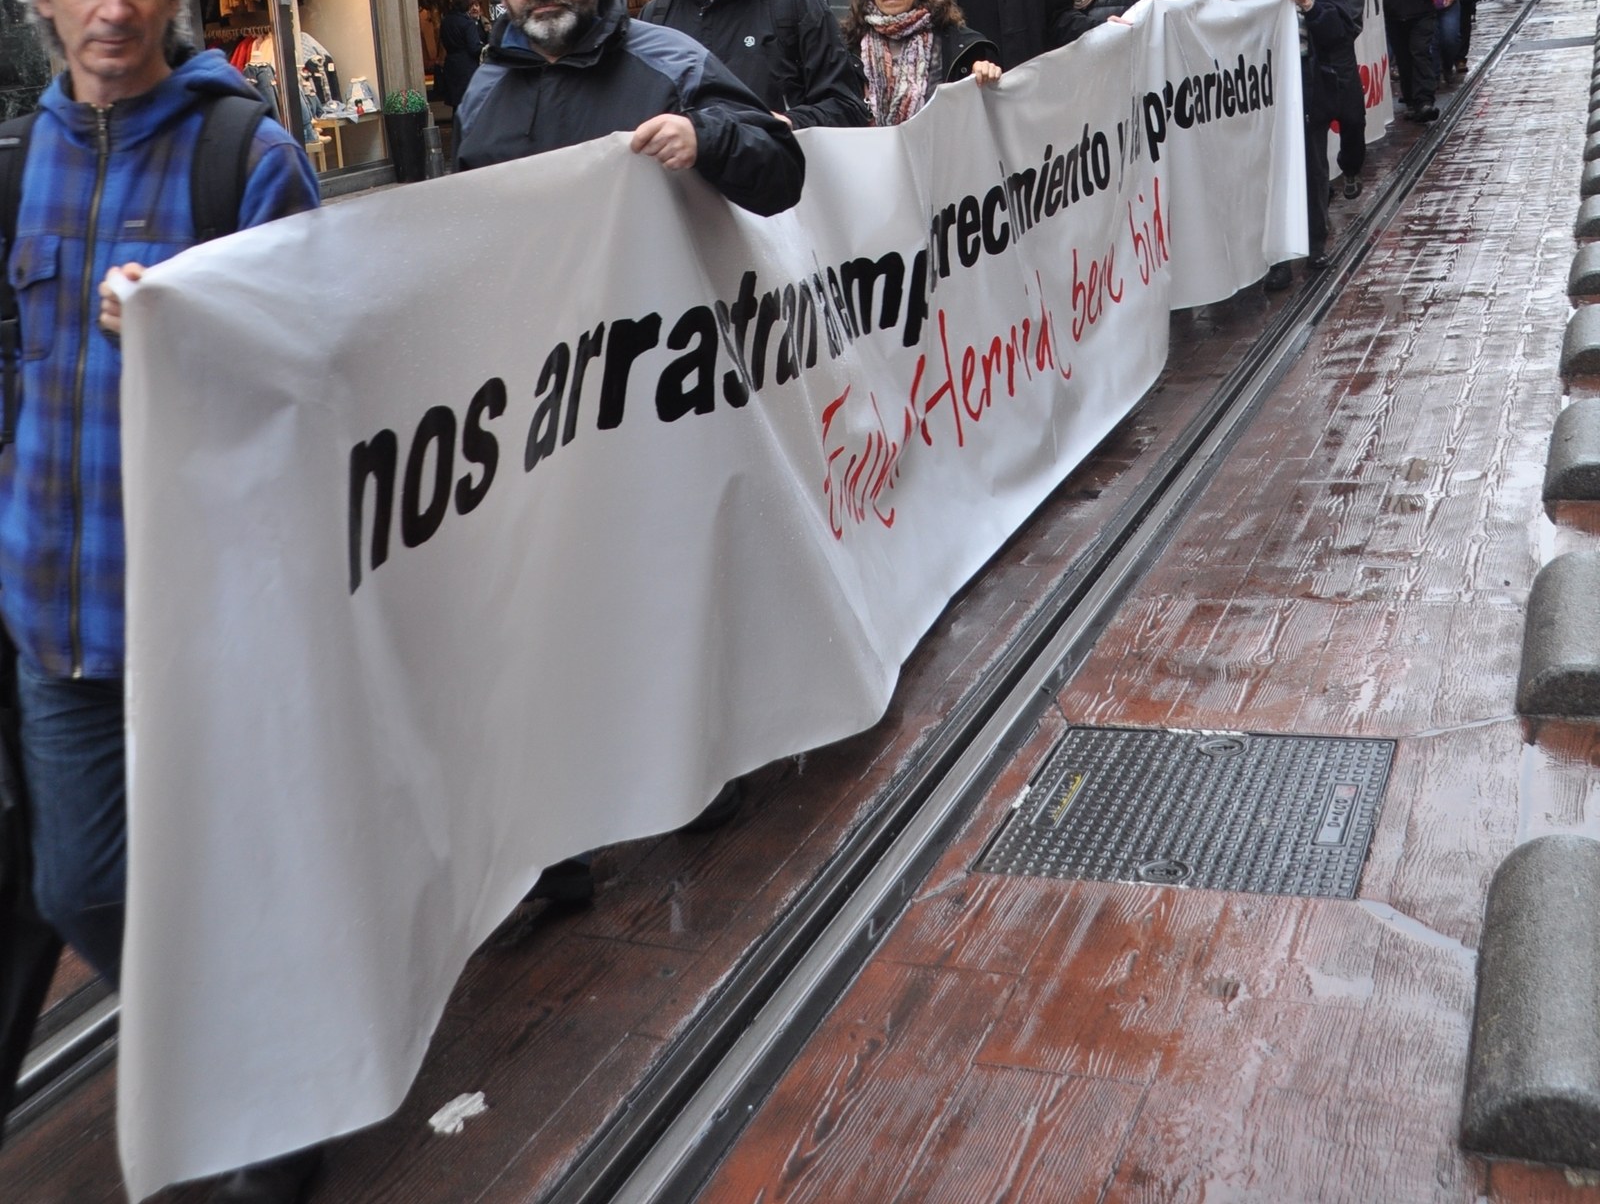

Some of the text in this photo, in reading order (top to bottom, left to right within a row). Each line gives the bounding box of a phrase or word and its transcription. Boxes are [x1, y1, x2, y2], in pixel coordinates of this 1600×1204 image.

[349, 377, 507, 596] nos
[525, 270, 818, 473] arrastran
[826, 123, 1111, 348] emprecimiento
[1143, 49, 1274, 163] pcariedad
